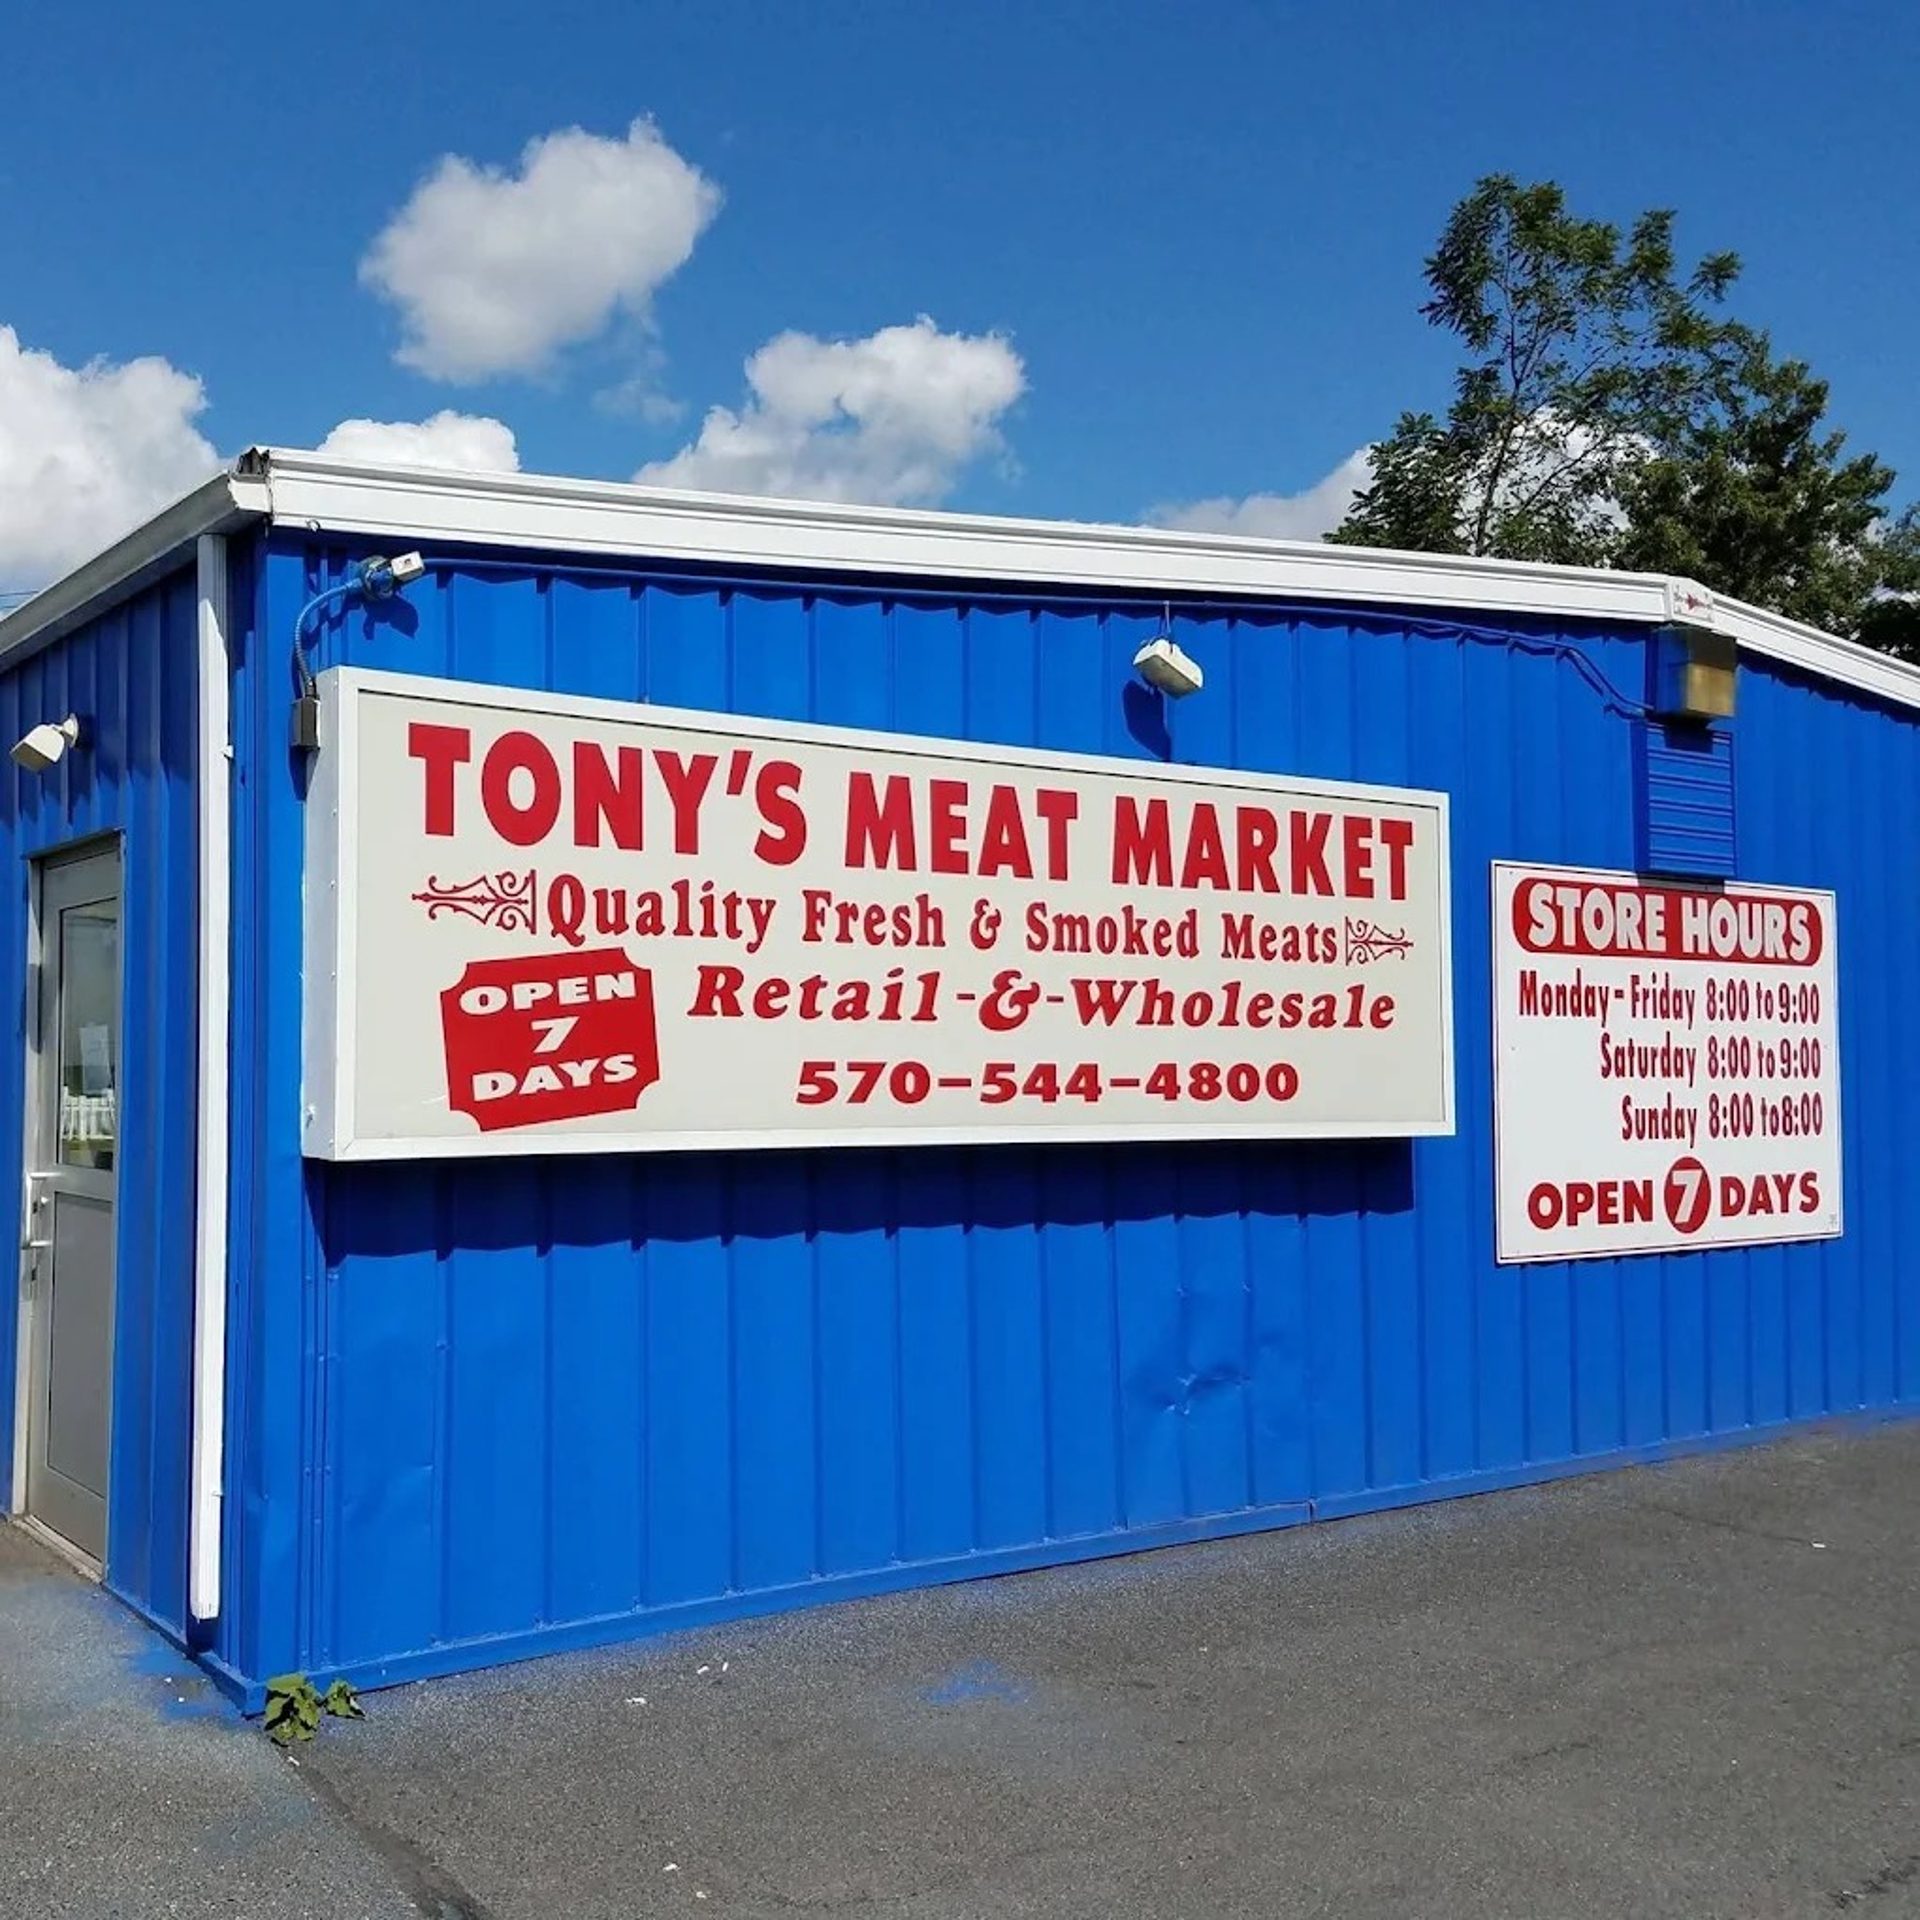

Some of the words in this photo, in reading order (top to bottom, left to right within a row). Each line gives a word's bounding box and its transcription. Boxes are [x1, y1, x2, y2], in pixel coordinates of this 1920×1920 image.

[408, 723, 808, 867] TONY'S
[845, 771, 1079, 882] MEAT
[1112, 796, 1414, 902] MARKET
[547, 873, 777, 954] Quality
[803, 889, 945, 947] Fresh
[970, 897, 1002, 951] &
[1026, 901, 1200, 959] Smoked
[1221, 913, 1338, 965] Meats
[1528, 882, 1668, 953] STORE
[1682, 897, 1812, 963] HOURS
[459, 971, 638, 1015] OPEN
[687, 965, 941, 1023] Retail
[1706, 978, 1749, 1022] 8:00
[1756, 981, 1774, 1021] to
[1778, 982, 1820, 1024] 9:00
[531, 1016, 579, 1054] 7
[1600, 1031, 1697, 1087] Saturday
[1707, 1035, 1750, 1079] 8:00
[1757, 1039, 1776, 1079] to
[1779, 1037, 1821, 1079] 9:00
[472, 1053, 637, 1103] DAYS
[798, 1061, 1300, 1105] 570-544-4800
[1621, 1091, 1698, 1149] Sunday
[1708, 1093, 1753, 1137] 8:00
[1528, 1181, 1653, 1230] OPEN
[1671, 1168, 1704, 1225] 7
[1720, 1172, 1820, 1217] DAYS
